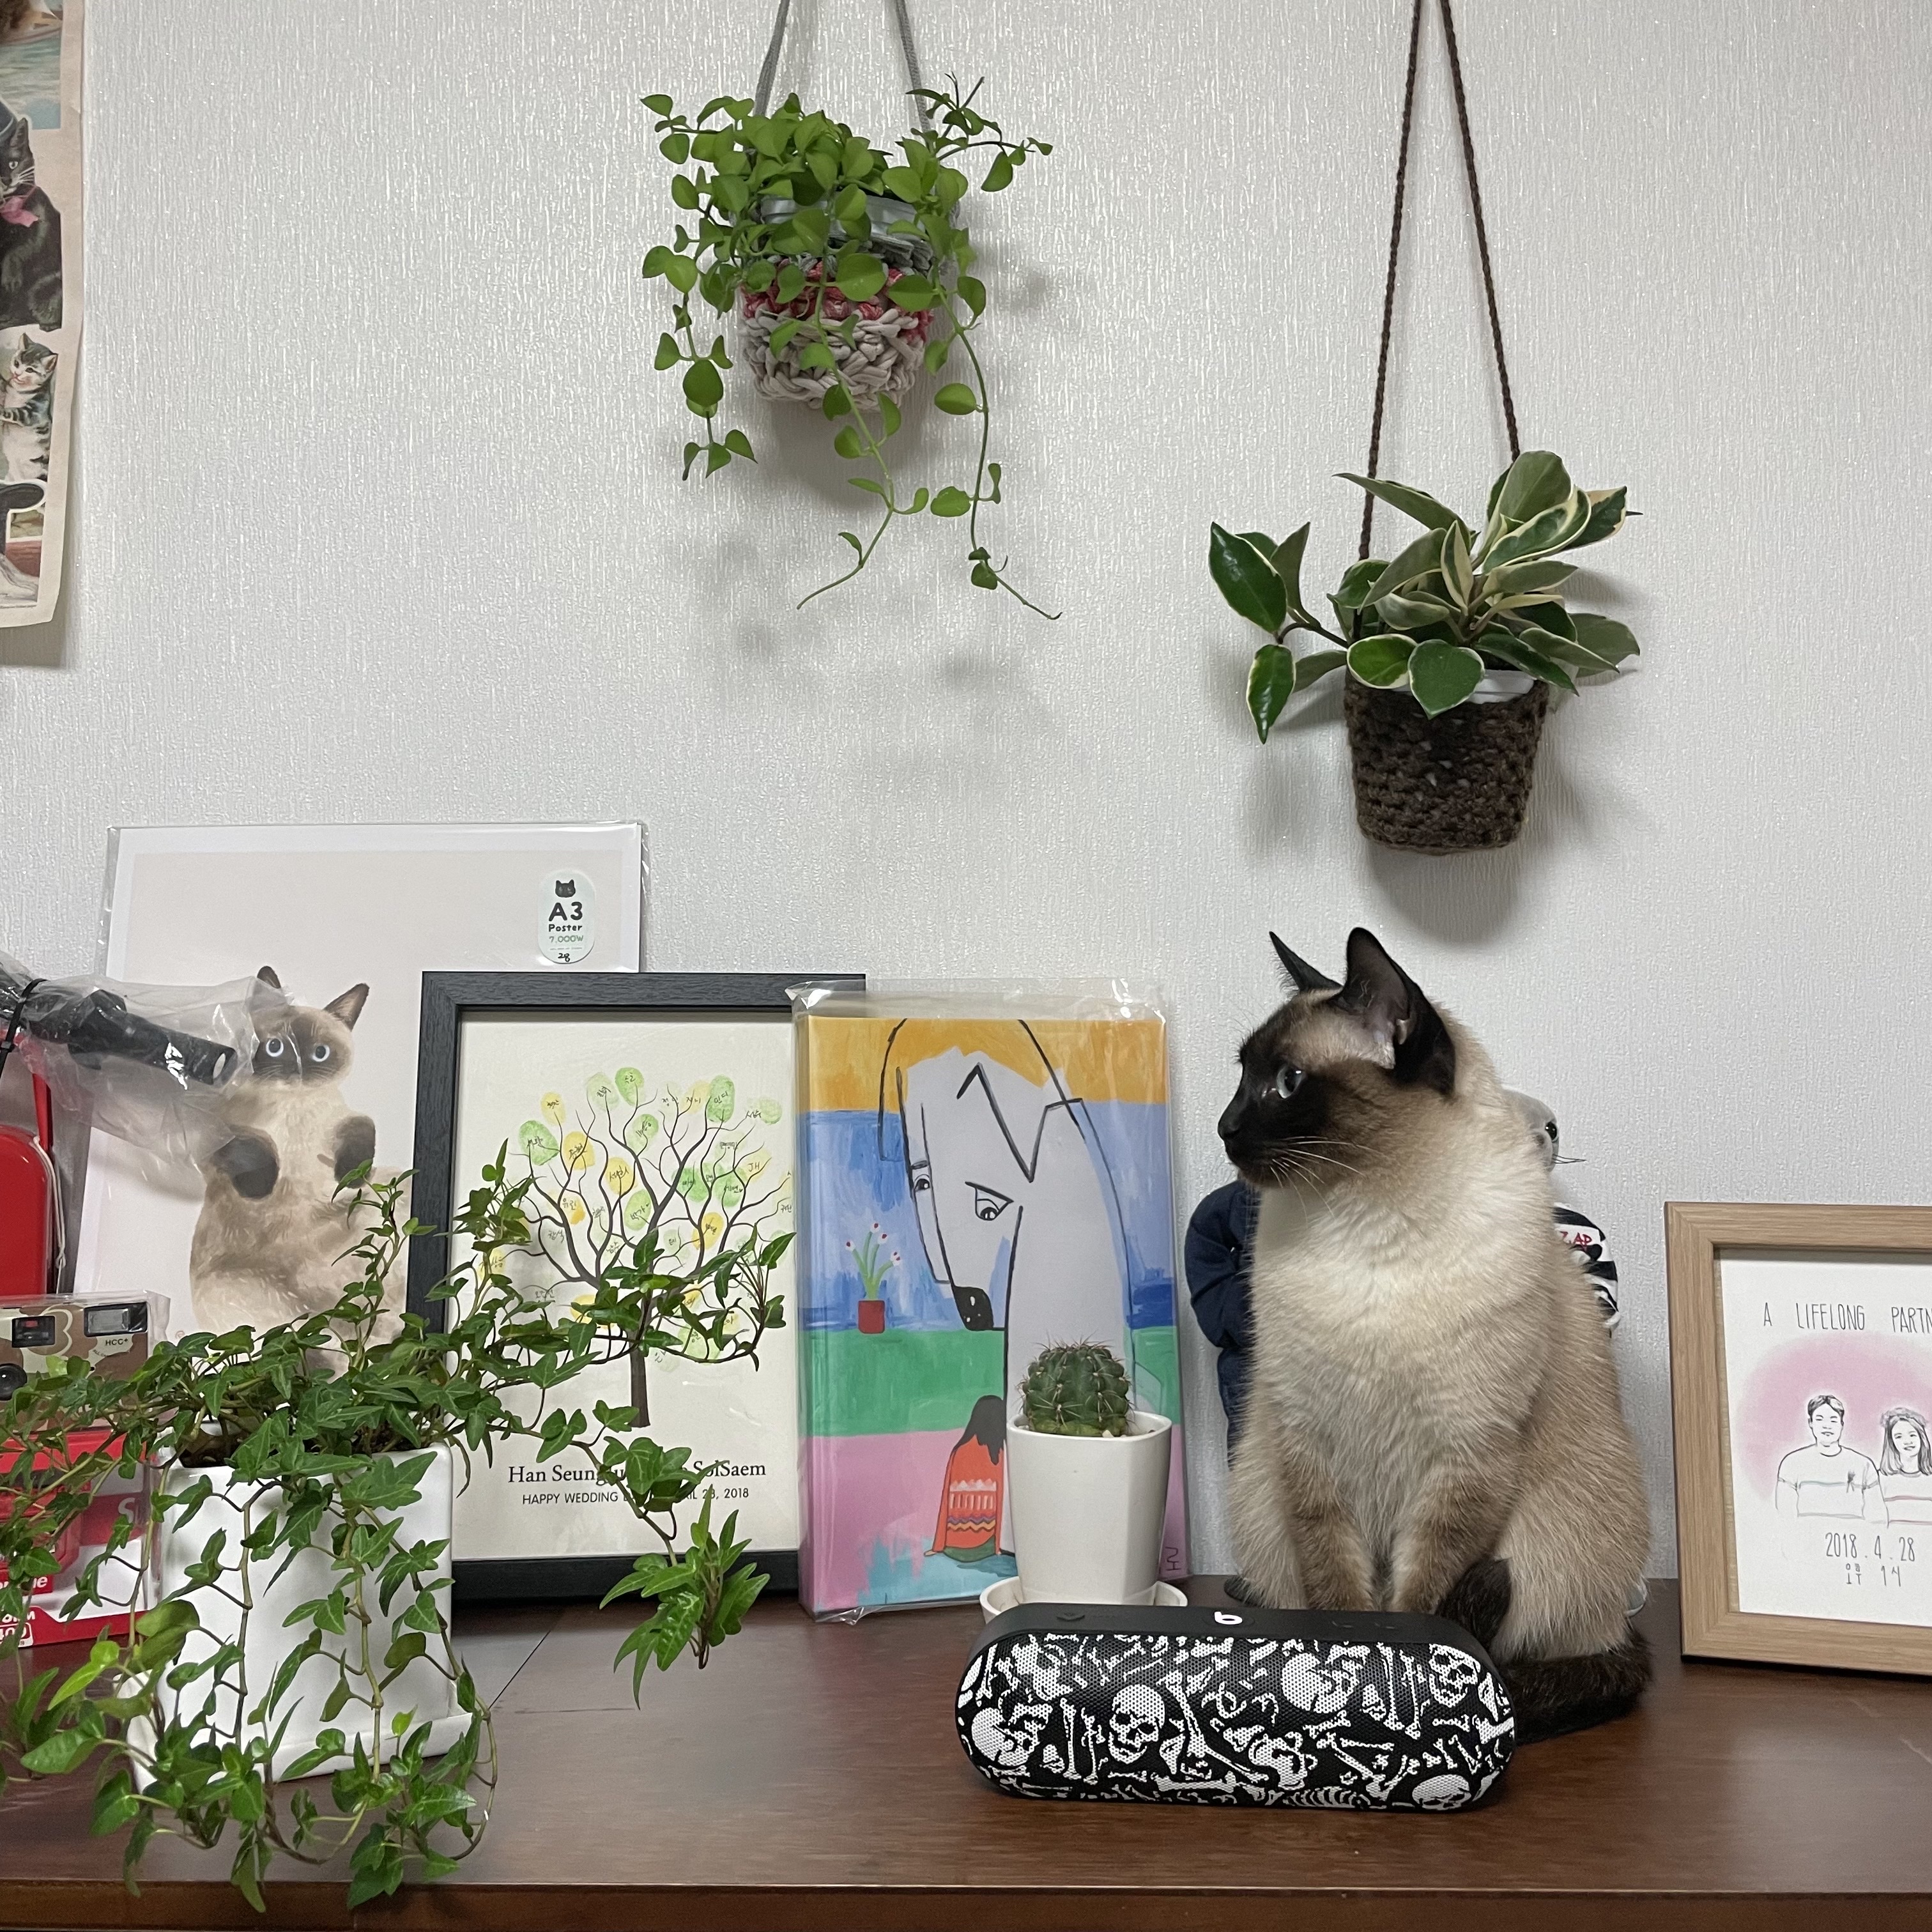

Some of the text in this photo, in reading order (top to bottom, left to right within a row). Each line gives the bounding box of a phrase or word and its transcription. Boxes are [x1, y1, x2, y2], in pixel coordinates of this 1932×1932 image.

[549, 901, 583, 921] A3
[548, 924, 583, 932] Poster
[1763, 1301, 1773, 1327] A
[1795, 1302, 1866, 1331] LIFELONG
[508, 1466, 547, 1483] Han
[523, 1493, 560, 1505] HAPPY
[565, 1491, 618, 1503] WEDDING
[724, 1487, 749, 1499] 2018
